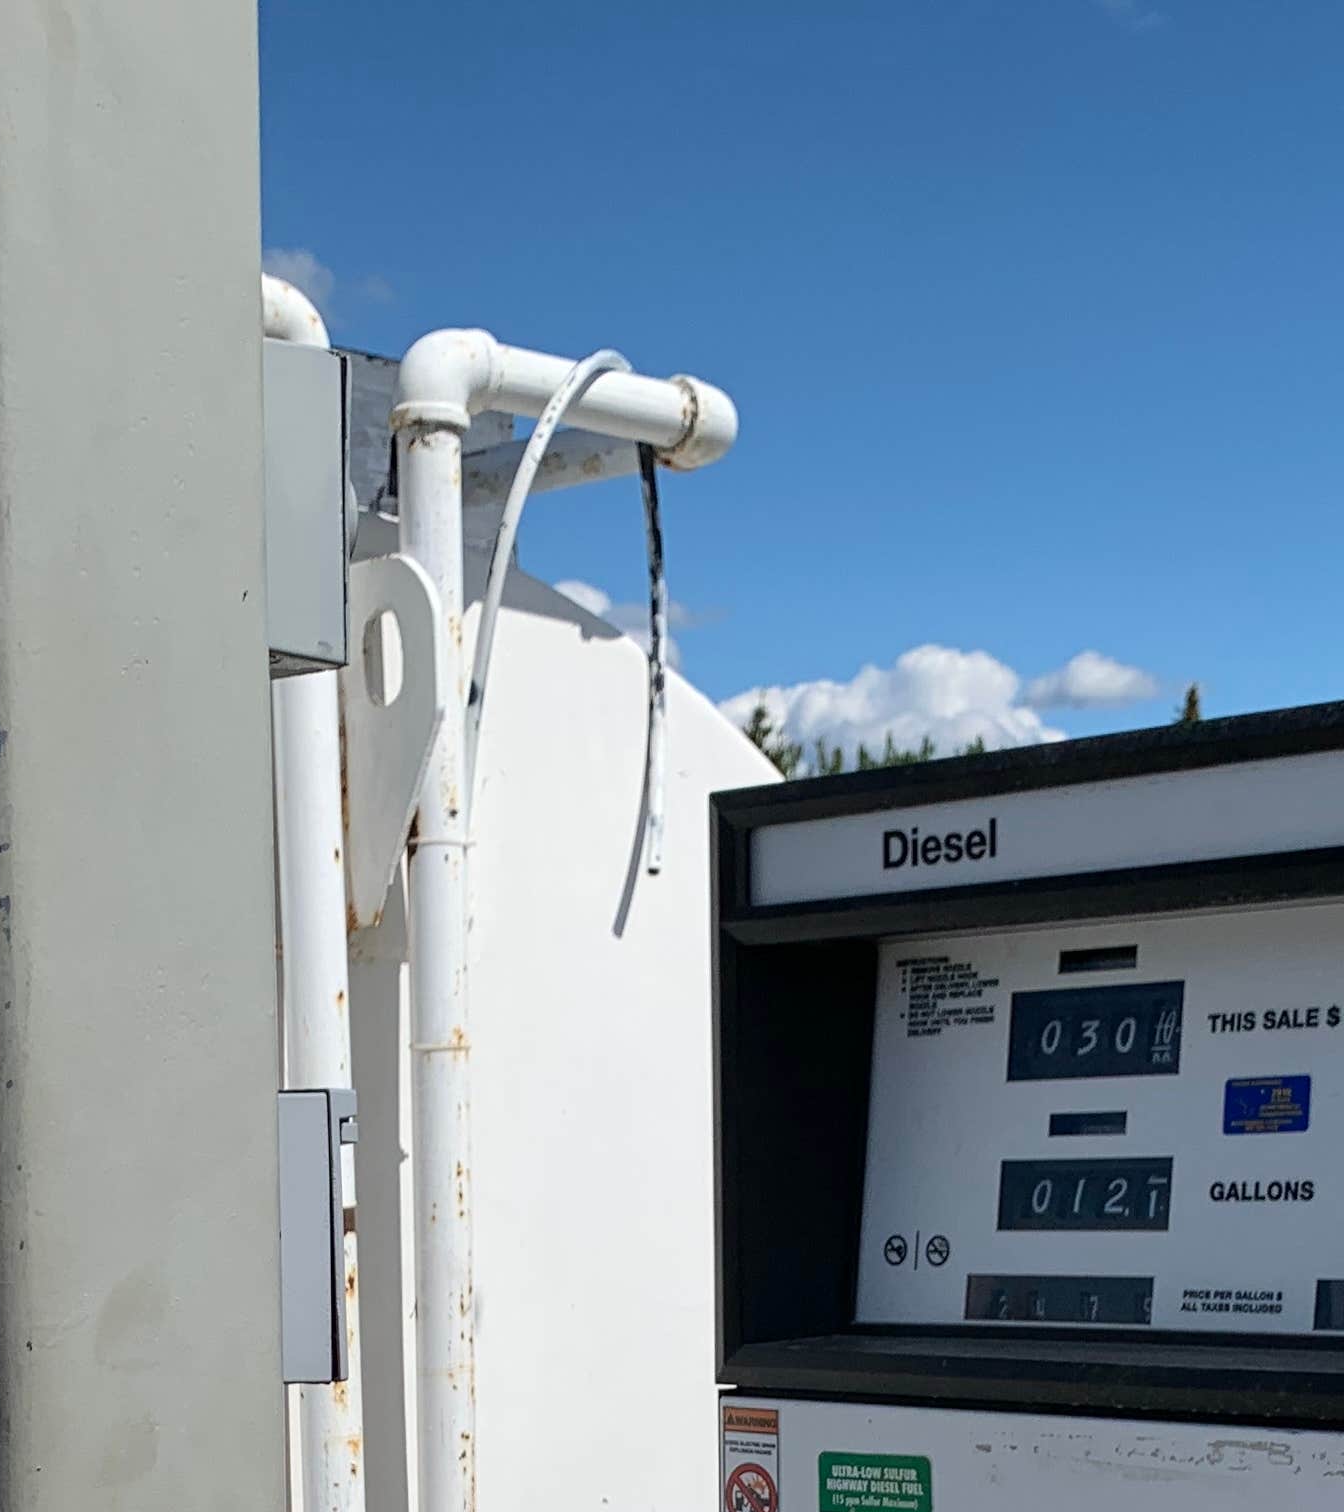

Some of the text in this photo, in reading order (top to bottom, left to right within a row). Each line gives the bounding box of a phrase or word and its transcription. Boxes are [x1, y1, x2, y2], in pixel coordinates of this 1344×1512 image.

[881, 817, 998, 871] Diesel
[1208, 1005, 1341, 1033] THIS SALE $
[1210, 1180, 1315, 1203] GALLONS
[1183, 1290, 1211, 1300] PRICE
[1214, 1290, 1232, 1300] PER
[1235, 1290, 1274, 1301] GALLON
[1181, 1303, 1282, 1314] ALL TAXES INCLUDED
[831, 1464, 918, 1481] ULTRA-LOW SULFUR
[826, 1478, 924, 1496] HIGHWAY DIESEL FUEL
